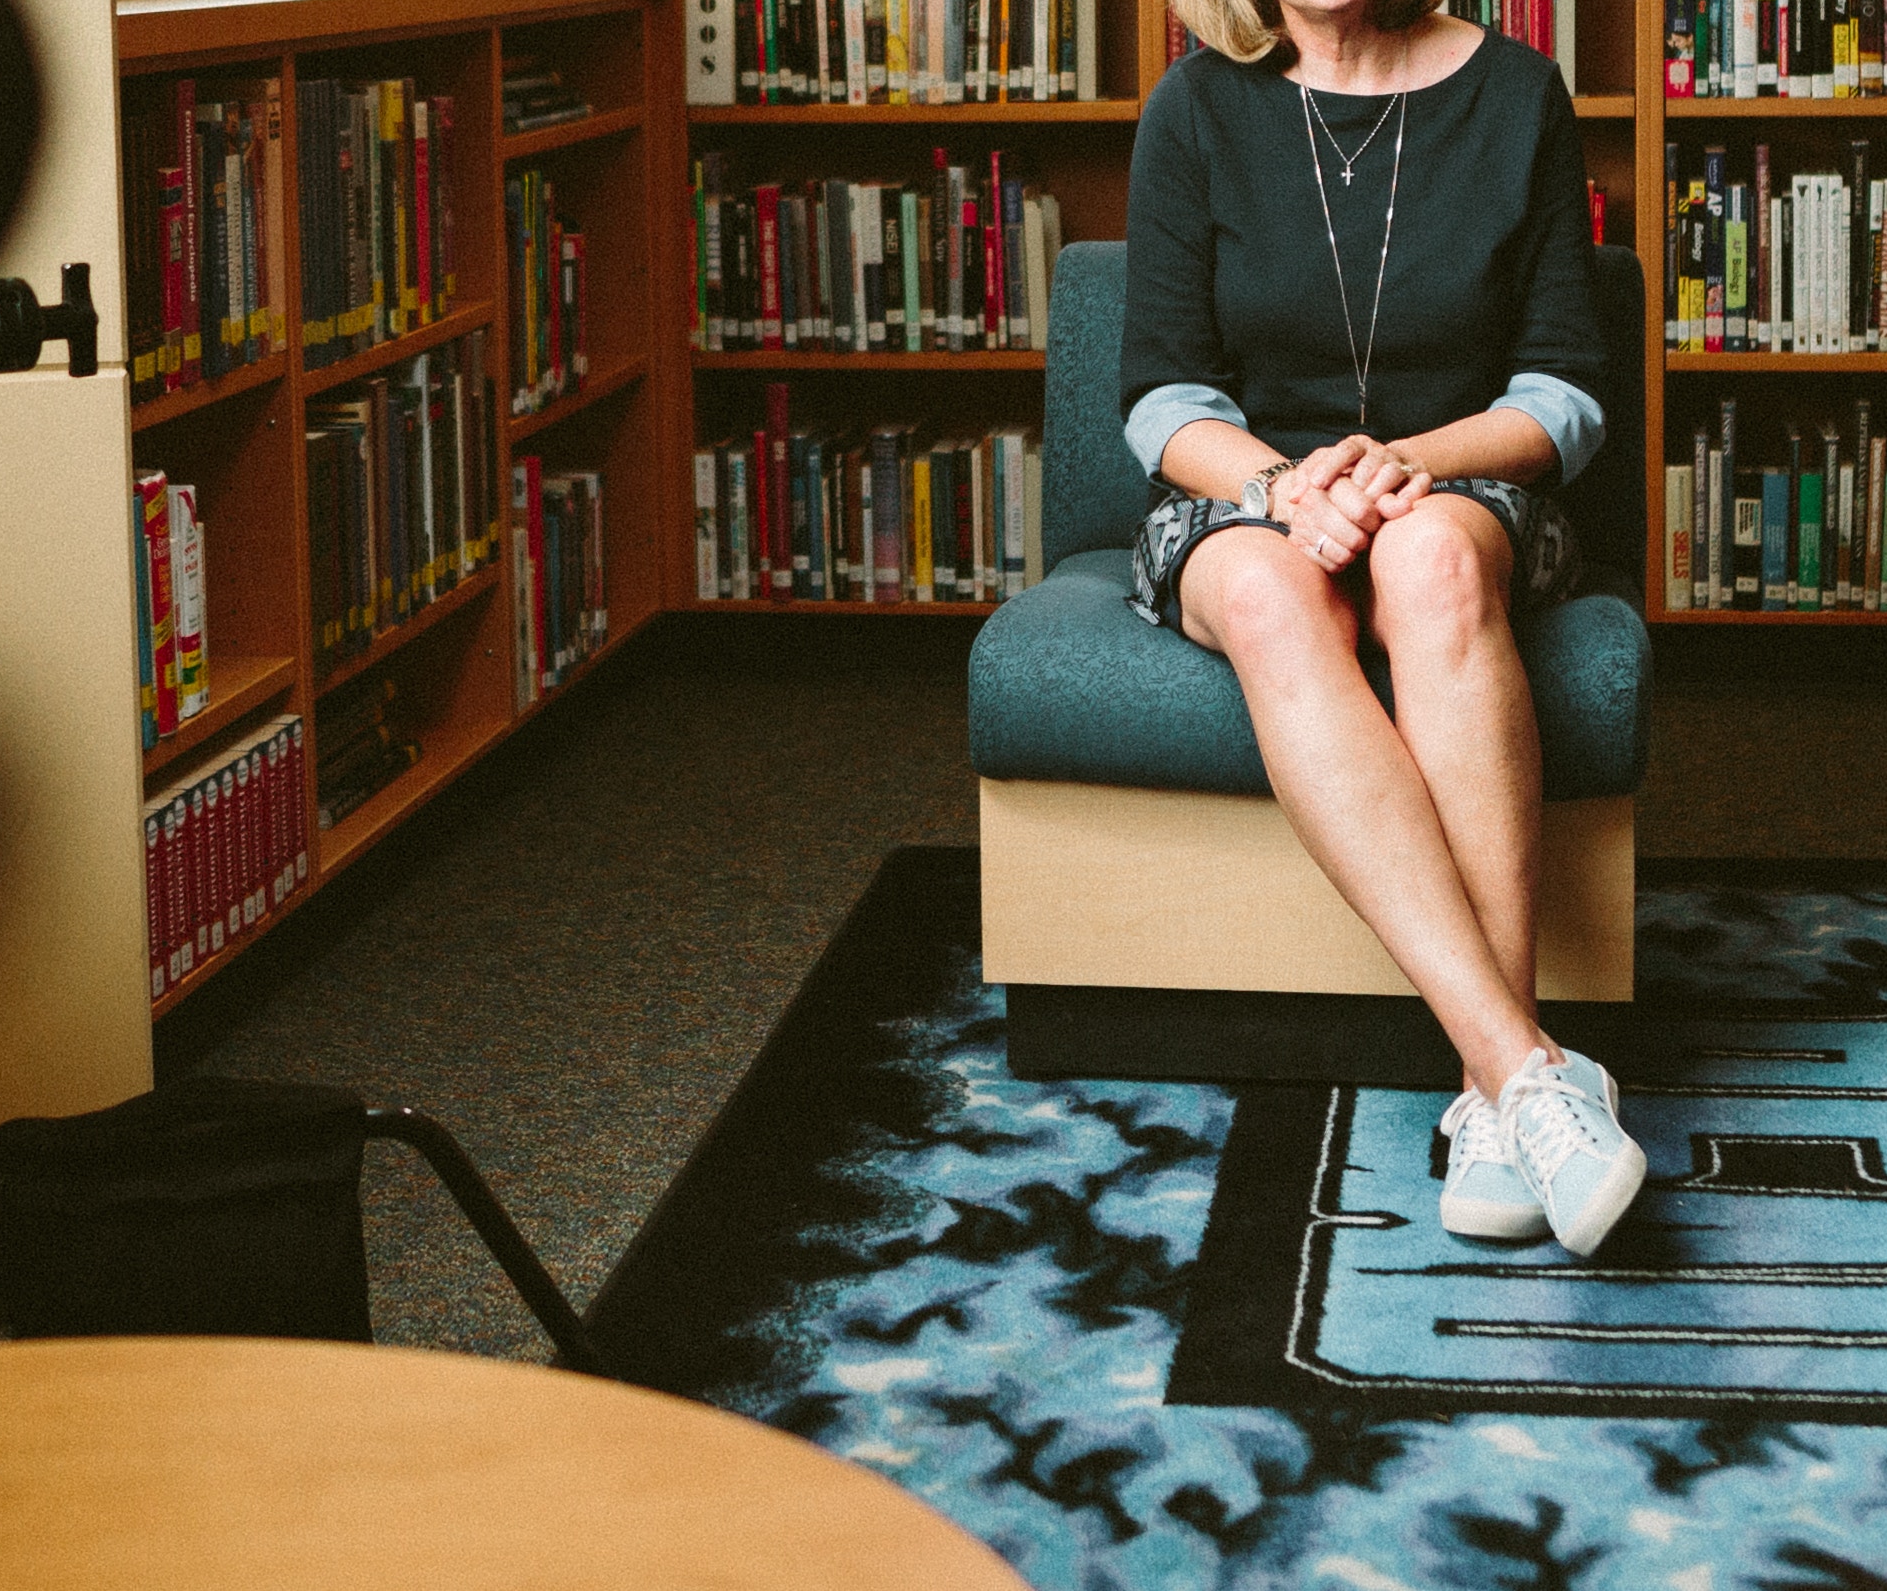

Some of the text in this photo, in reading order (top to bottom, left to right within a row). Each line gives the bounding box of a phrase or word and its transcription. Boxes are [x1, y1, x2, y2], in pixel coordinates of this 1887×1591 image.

[184, 108, 199, 304] Environmental Encyclopedia
[1706, 190, 1724, 217] AP
[764, 220, 776, 241] THE
[1691, 220, 1705, 263] Biology
[1730, 257, 1742, 298] Biology
[1673, 530, 1690, 579] SHELLS
